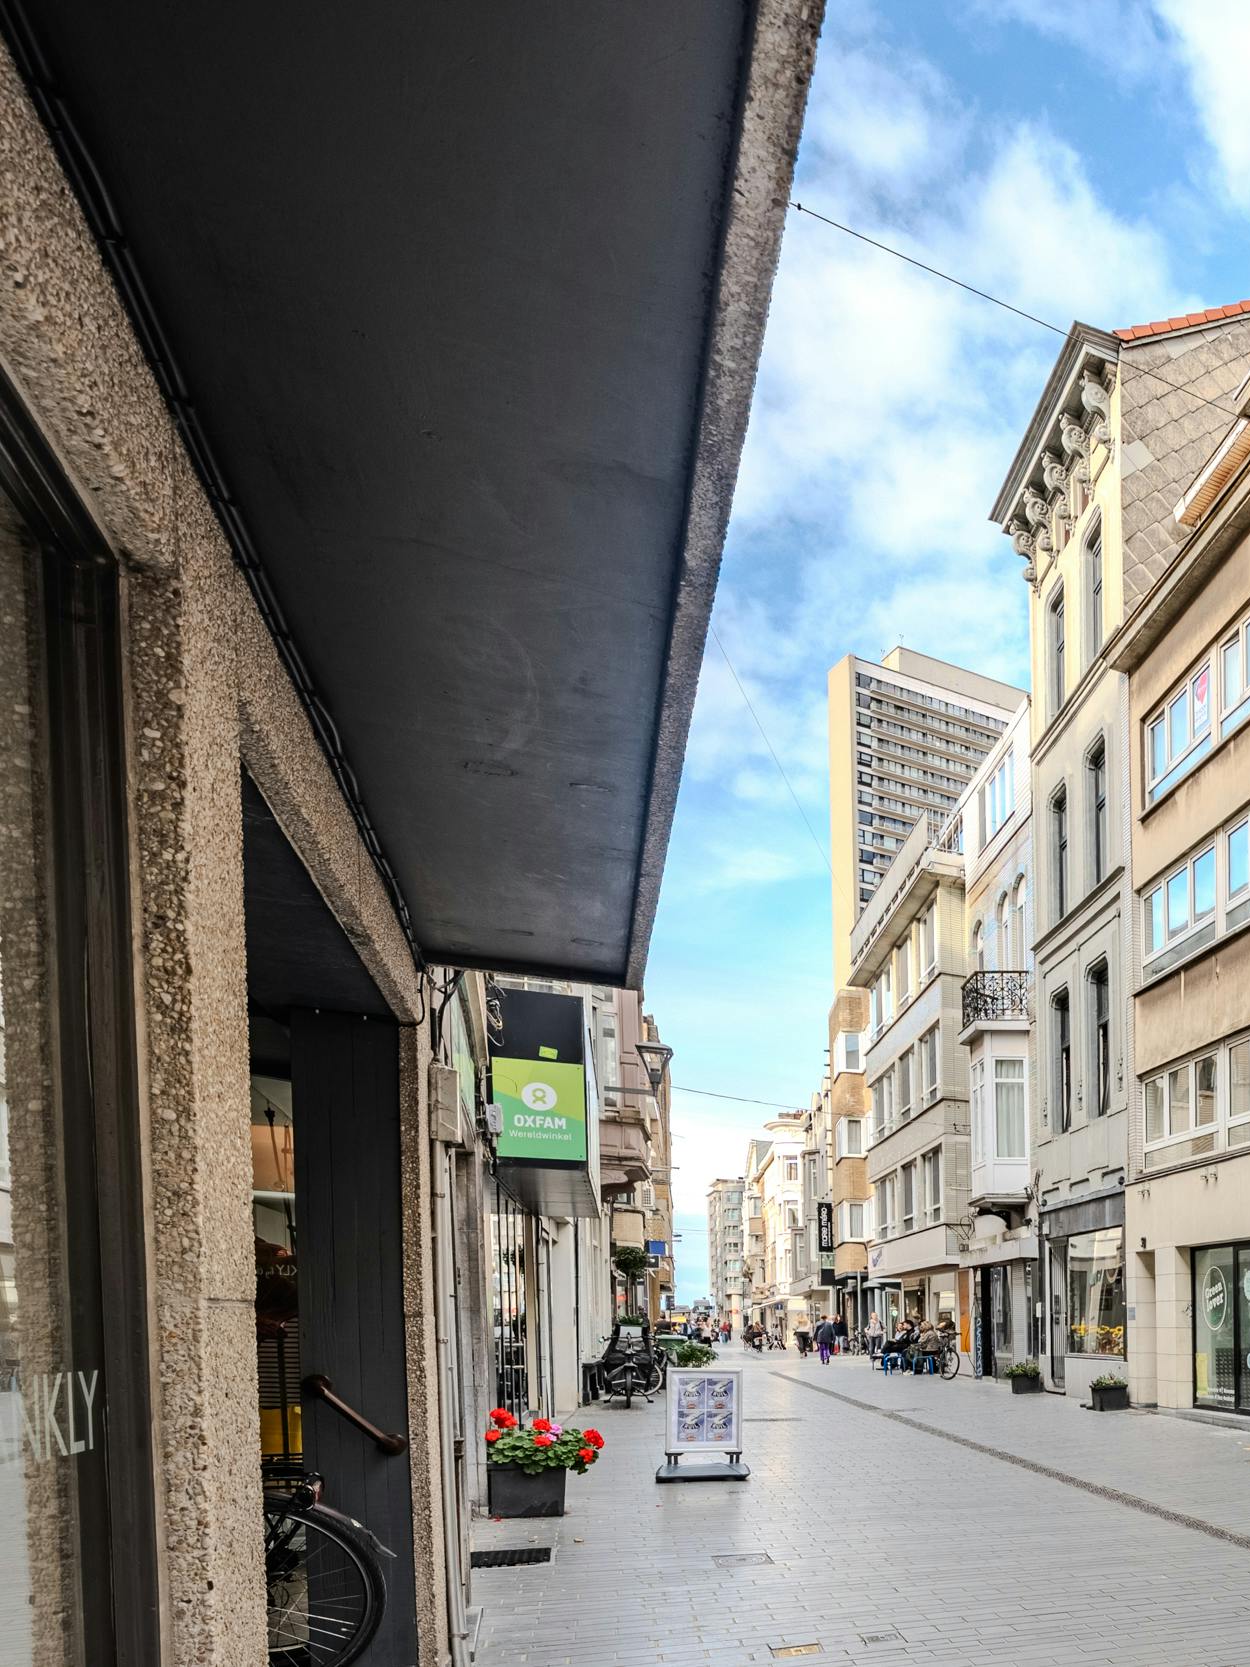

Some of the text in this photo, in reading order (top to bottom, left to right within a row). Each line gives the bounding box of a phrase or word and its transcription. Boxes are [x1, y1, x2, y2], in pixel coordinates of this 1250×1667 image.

[514, 1114, 567, 1130] OXFAM
[508, 1130, 572, 1141] Wereldwinkel
[1205, 1281, 1223, 1298] Green
[1206, 1293, 1224, 1312] lover
